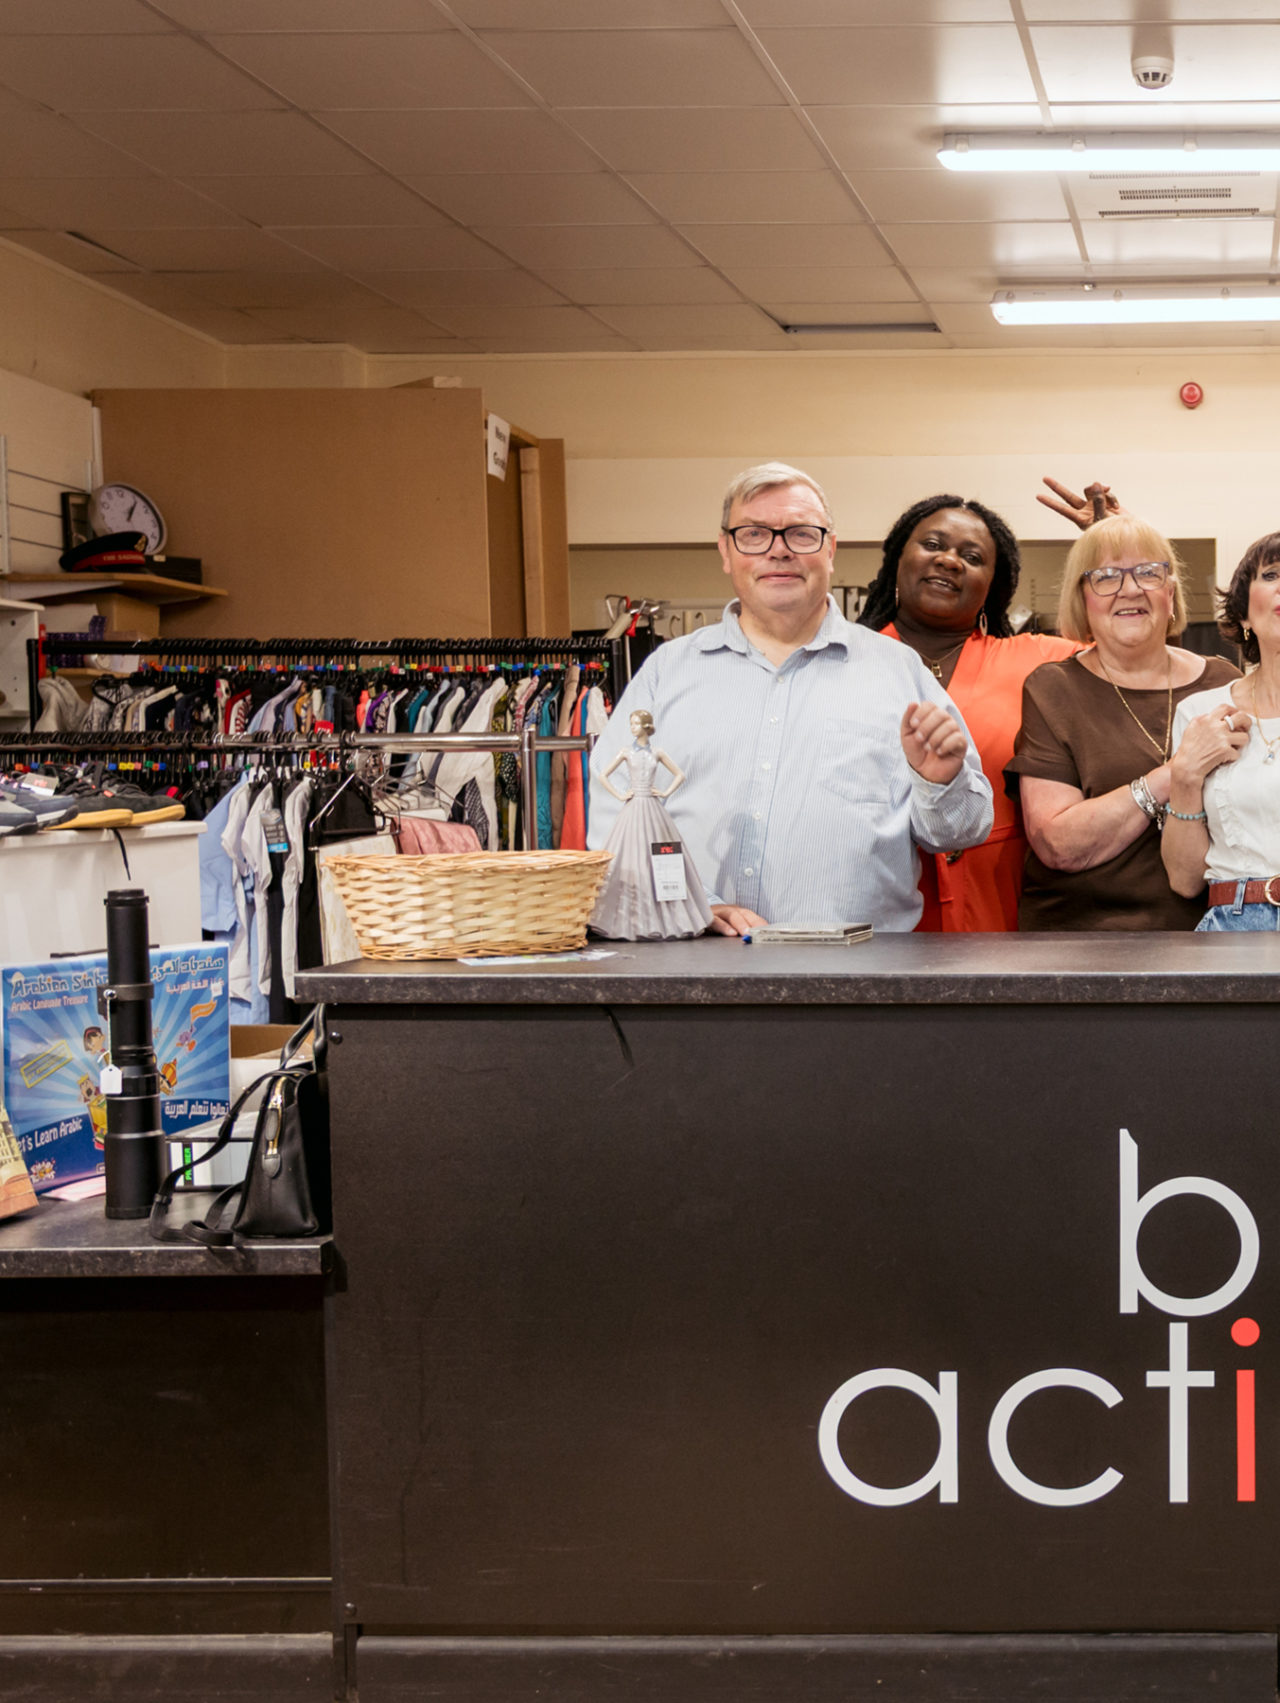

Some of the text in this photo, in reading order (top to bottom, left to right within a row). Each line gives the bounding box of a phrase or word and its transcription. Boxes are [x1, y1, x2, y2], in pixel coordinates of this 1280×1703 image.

[10, 973, 69, 998] Arabian
[18, 1116, 82, 1152] et's Learn Arabic
